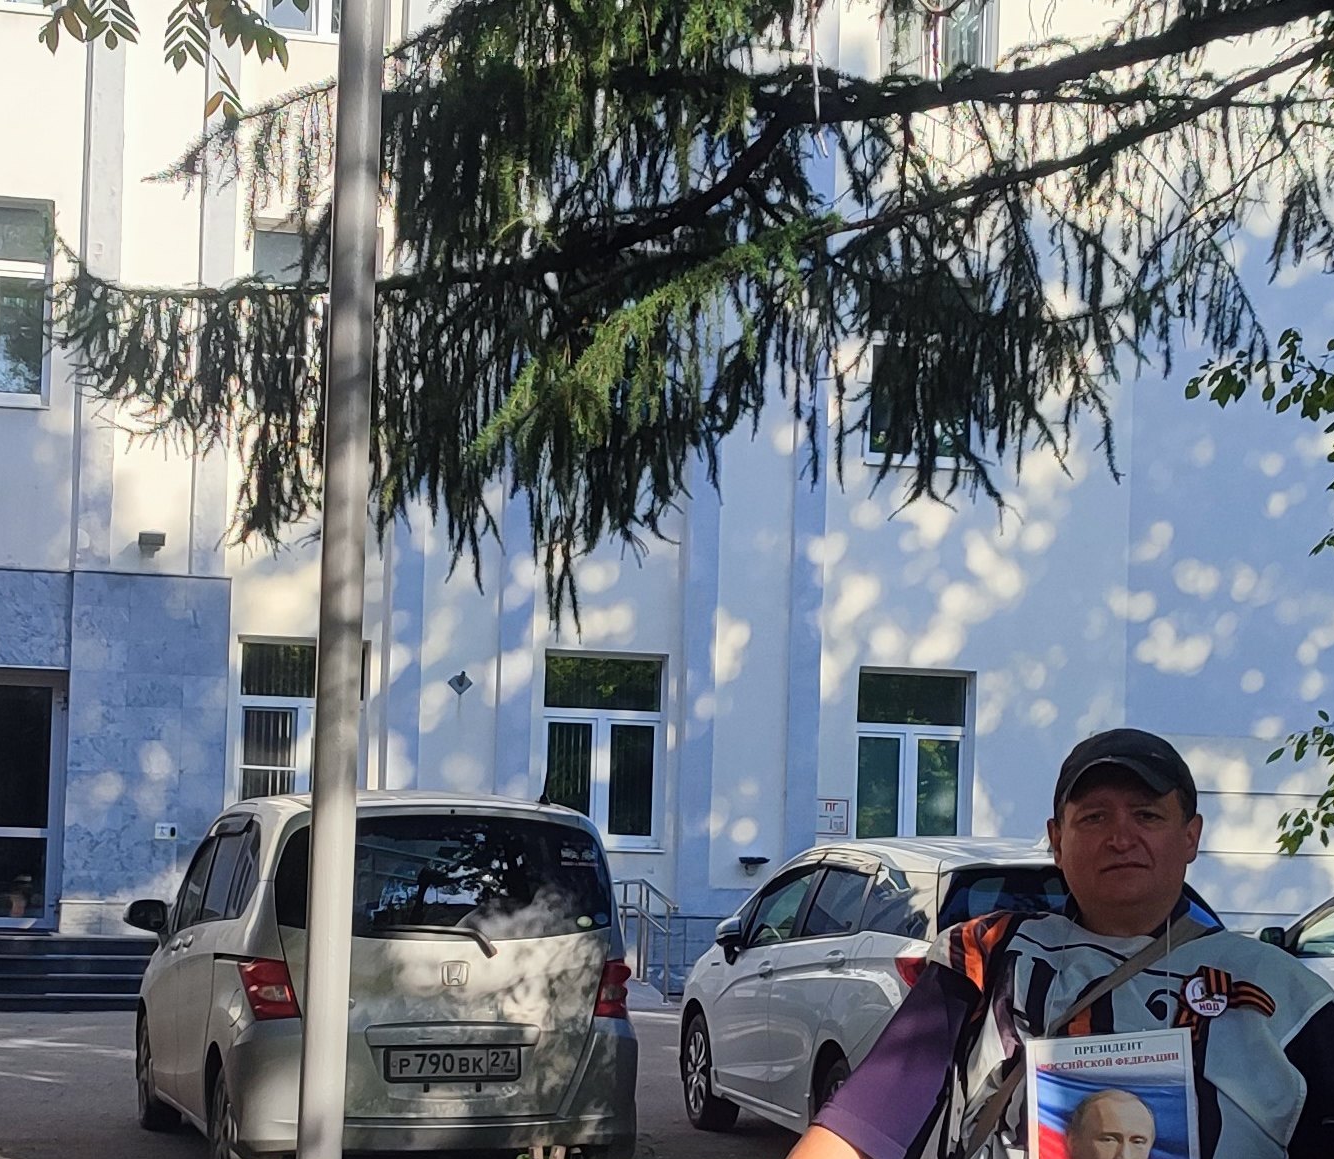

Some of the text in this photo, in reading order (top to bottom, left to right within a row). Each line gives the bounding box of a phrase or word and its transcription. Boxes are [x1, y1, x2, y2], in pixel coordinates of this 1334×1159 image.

[1074, 1041, 1143, 1055] ПРЕЗИДЕНТ
[490, 1051, 511, 1067] 27
[1116, 1052, 1179, 1067] ФЕДЕРАЦИИ
